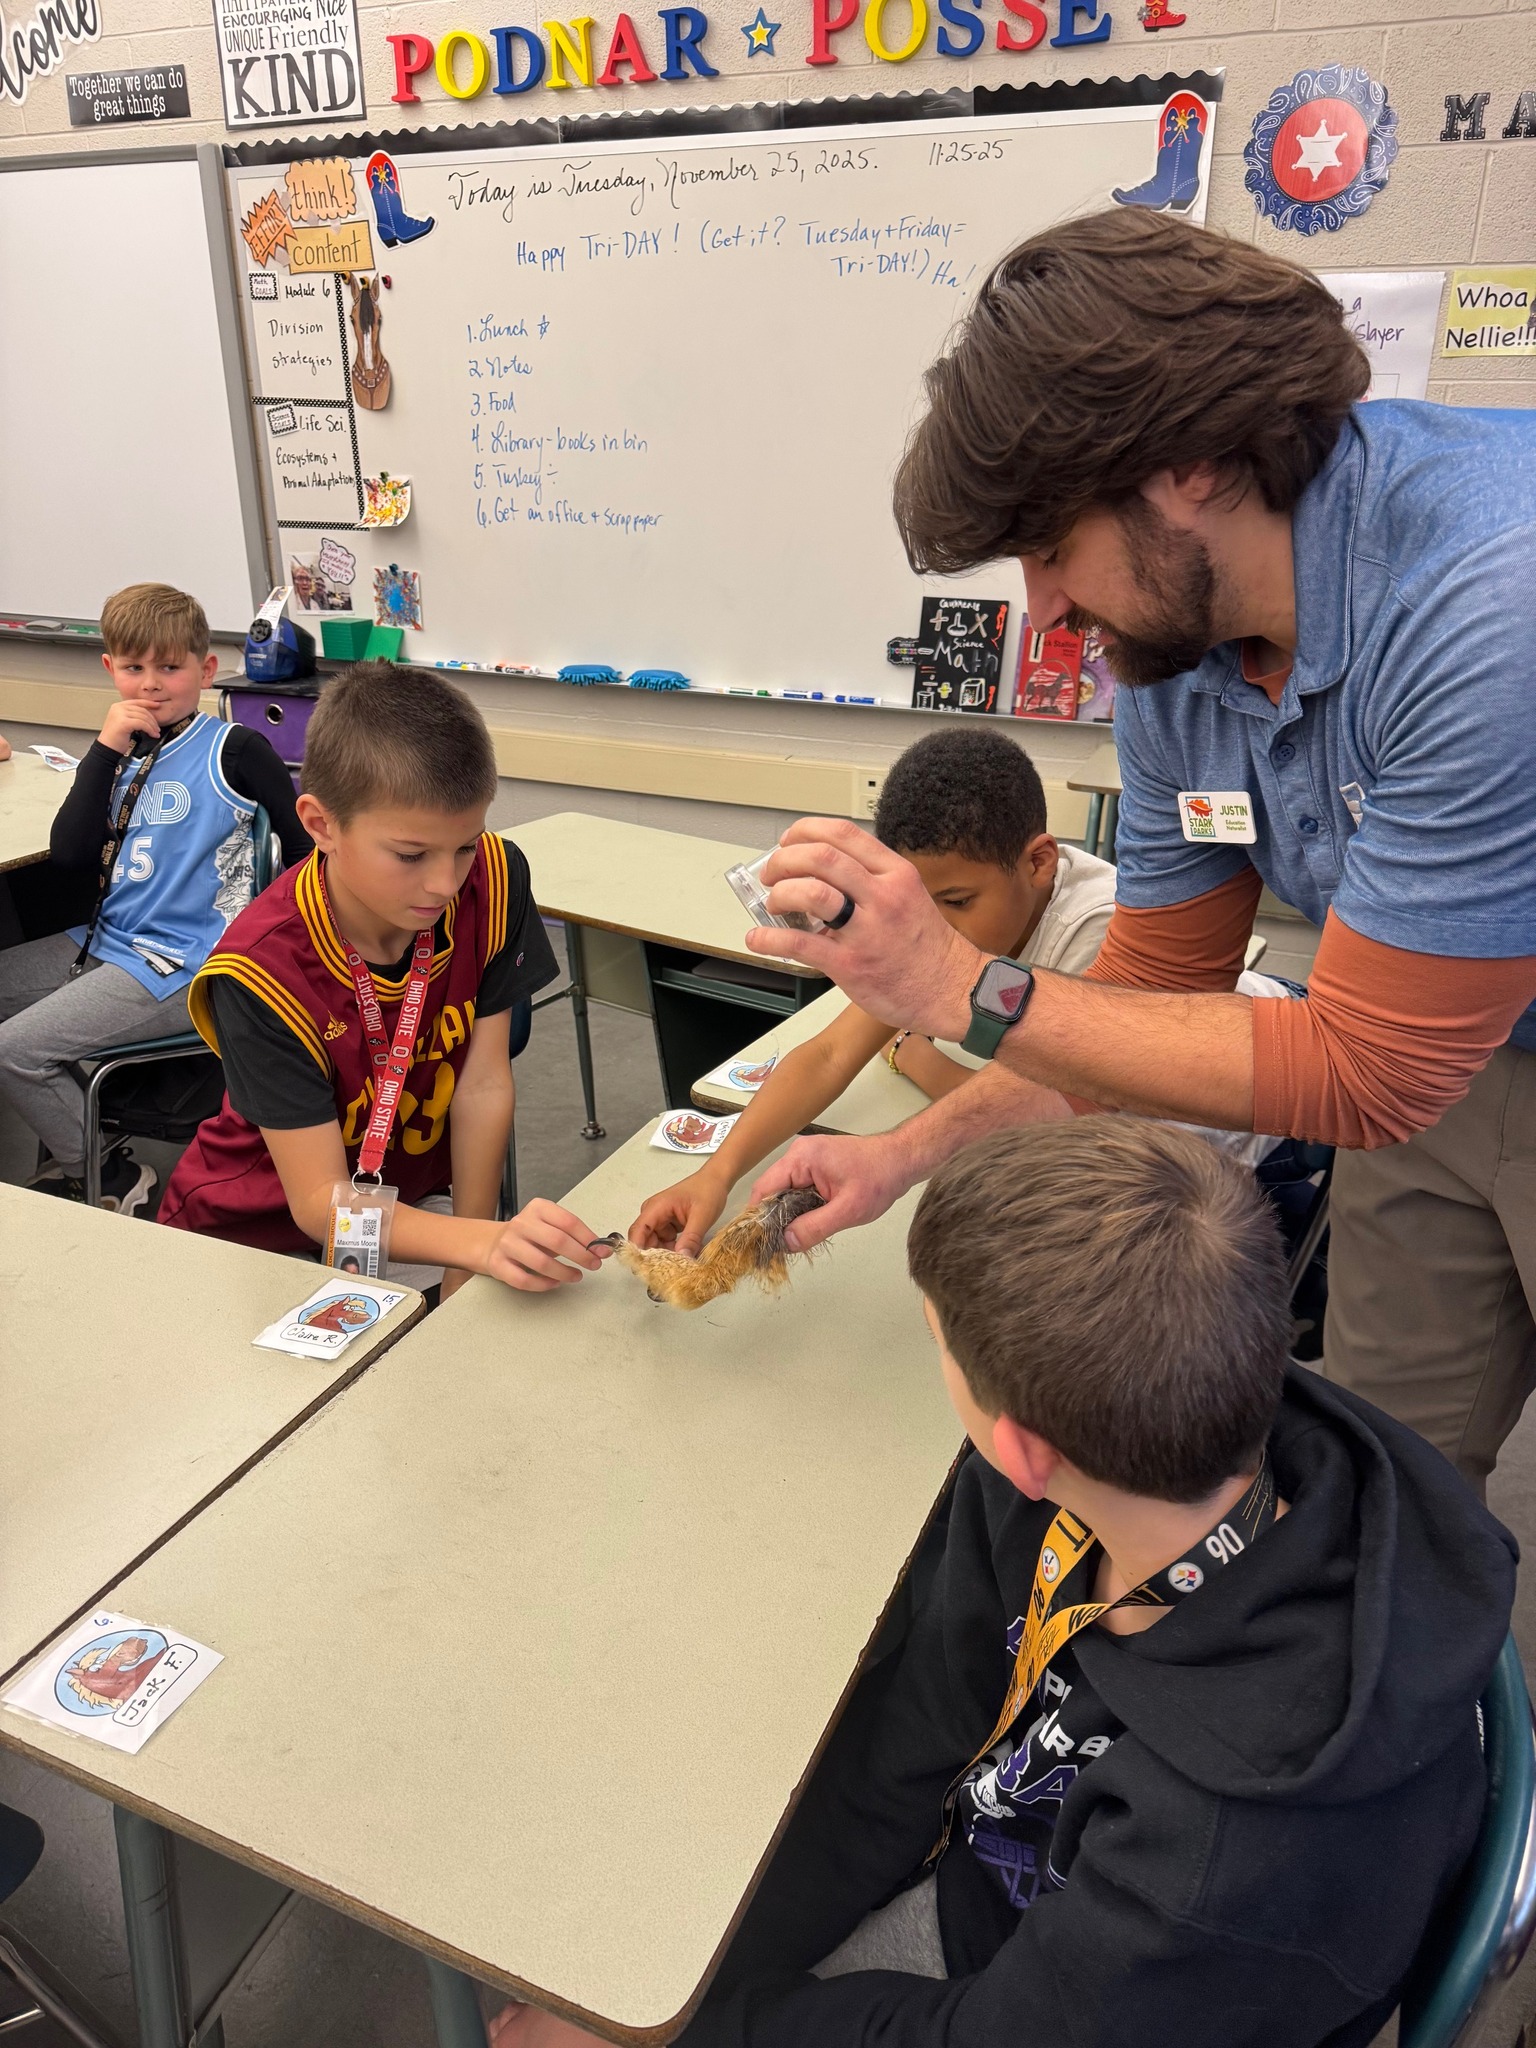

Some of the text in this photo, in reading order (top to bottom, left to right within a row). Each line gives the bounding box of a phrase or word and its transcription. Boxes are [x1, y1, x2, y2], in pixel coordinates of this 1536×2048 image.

[223, 6, 311, 28] ENCOURAGING
[225, 19, 348, 53] UNIQUE Friendly
[386, 0, 1112, 103] PODNAR POSSE
[69, 68, 183, 99] Together we can do
[227, 48, 356, 119] KIND
[93, 95, 166, 121] great things
[292, 168, 350, 210] think!
[448, 170, 515, 223] Today
[528, 174, 552, 199] is
[558, 160, 654, 216] Tuesday,
[656, 156, 759, 209] November
[767, 150, 805, 182] 25,
[814, 147, 878, 173] 2025.
[249, 197, 287, 257] EFFORT
[292, 233, 361, 266] content
[516, 241, 565, 272] Happy
[285, 278, 331, 299] Module 6
[1456, 286, 1528, 308] Whoa
[268, 319, 324, 337] Division
[272, 351, 333, 376] strategies
[485, 355, 533, 378] Notes
[489, 391, 517, 414] Food
[300, 414, 322, 431] Life
[602, 435, 619, 452] in
[623, 428, 648, 454] bin
[276, 446, 329, 468] Ecosystems
[494, 496, 519, 524] Get
[528, 507, 544, 522] an
[548, 500, 588, 525] office
[952, 637, 985, 650] Science
[1188, 818, 1214, 828] STARK
[1219, 805, 1248, 816] JUSTIN
[1193, 827, 1213, 835] PARKS
[356, 973, 382, 1032] OHIO STATE
[398, 980, 425, 1038] OHIO STATE
[379, 1080, 399, 1106] OHIO
[369, 1106, 393, 1140] STATE
[1205, 1523, 1245, 1566] 90
